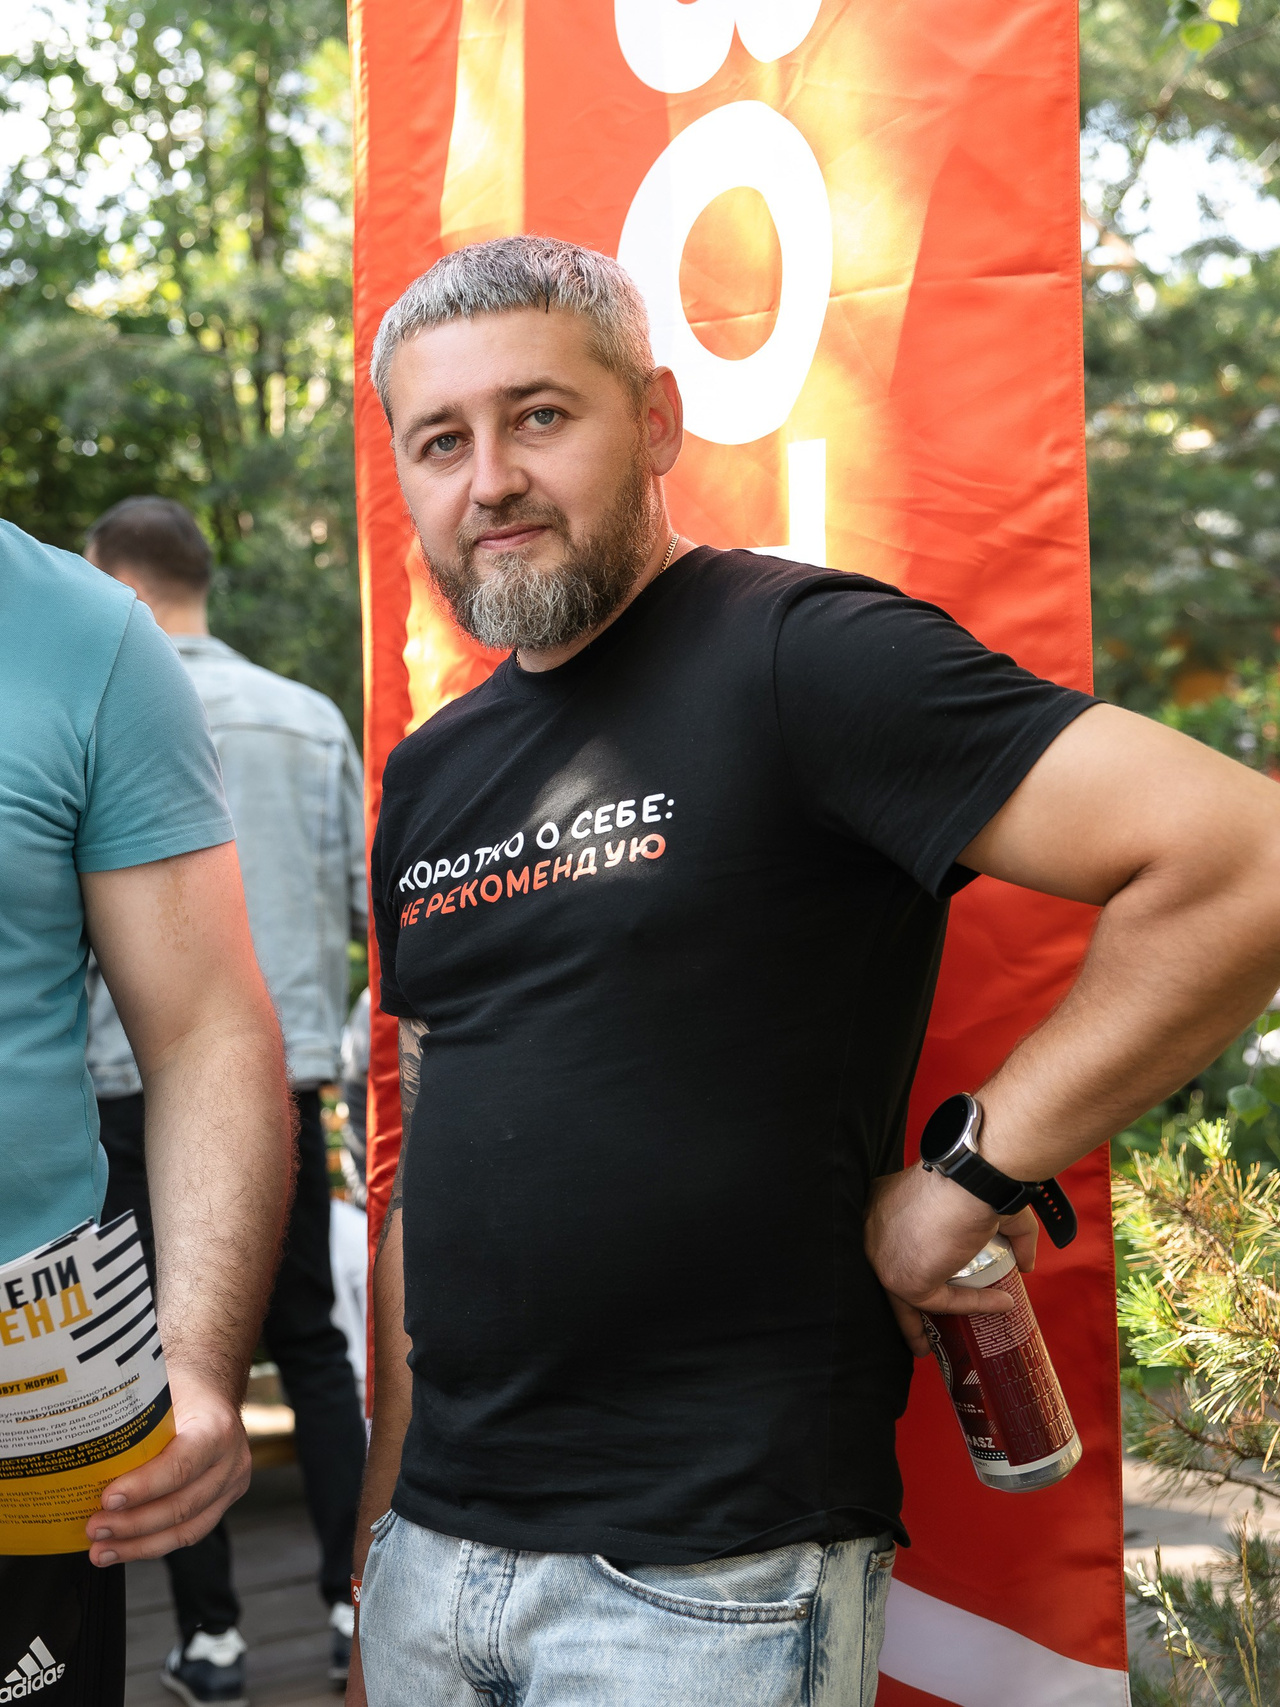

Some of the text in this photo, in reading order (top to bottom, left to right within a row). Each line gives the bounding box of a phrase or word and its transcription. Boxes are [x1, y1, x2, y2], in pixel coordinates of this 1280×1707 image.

[399, 793, 675, 892] КОРОТКО О СЕБЕ:
[400, 833, 667, 929] НЕ РЕКОМЕНДУЮ
[15, 1396, 99, 1422] РАЗРУШИТЕЛЕЙ
[101, 1373, 140, 1399] ЛЕГЕНД!
[24, 1374, 60, 1390] ЖОРЖ!
[41, 1385, 107, 1411] проводником
[0, 1426, 49, 1437] передаче,
[50, 1421, 66, 1431] где
[69, 1416, 86, 1426] два
[88, 1393, 133, 1419] солидных
[12, 1438, 54, 1448] легенды
[65, 1425, 100, 1441] прочие
[26, 1429, 68, 1441] направо
[79, 1413, 113, 1428] налево
[115, 1398, 141, 1416] слухи,
[44, 1448, 76, 1459] СТАТЬ
[78, 1403, 156, 1452] БЕССТРАШНЫМИ
[26, 1459, 87, 1475] ИЗВЕСТНЫХ
[90, 1440, 131, 1462] ЛЕГЕНД!
[30, 1455, 75, 1468] ПРАВДЫ
[87, 1420, 149, 1455] РАЗГРОМИТЬ
[44, 1483, 96, 1495] разбивать,
